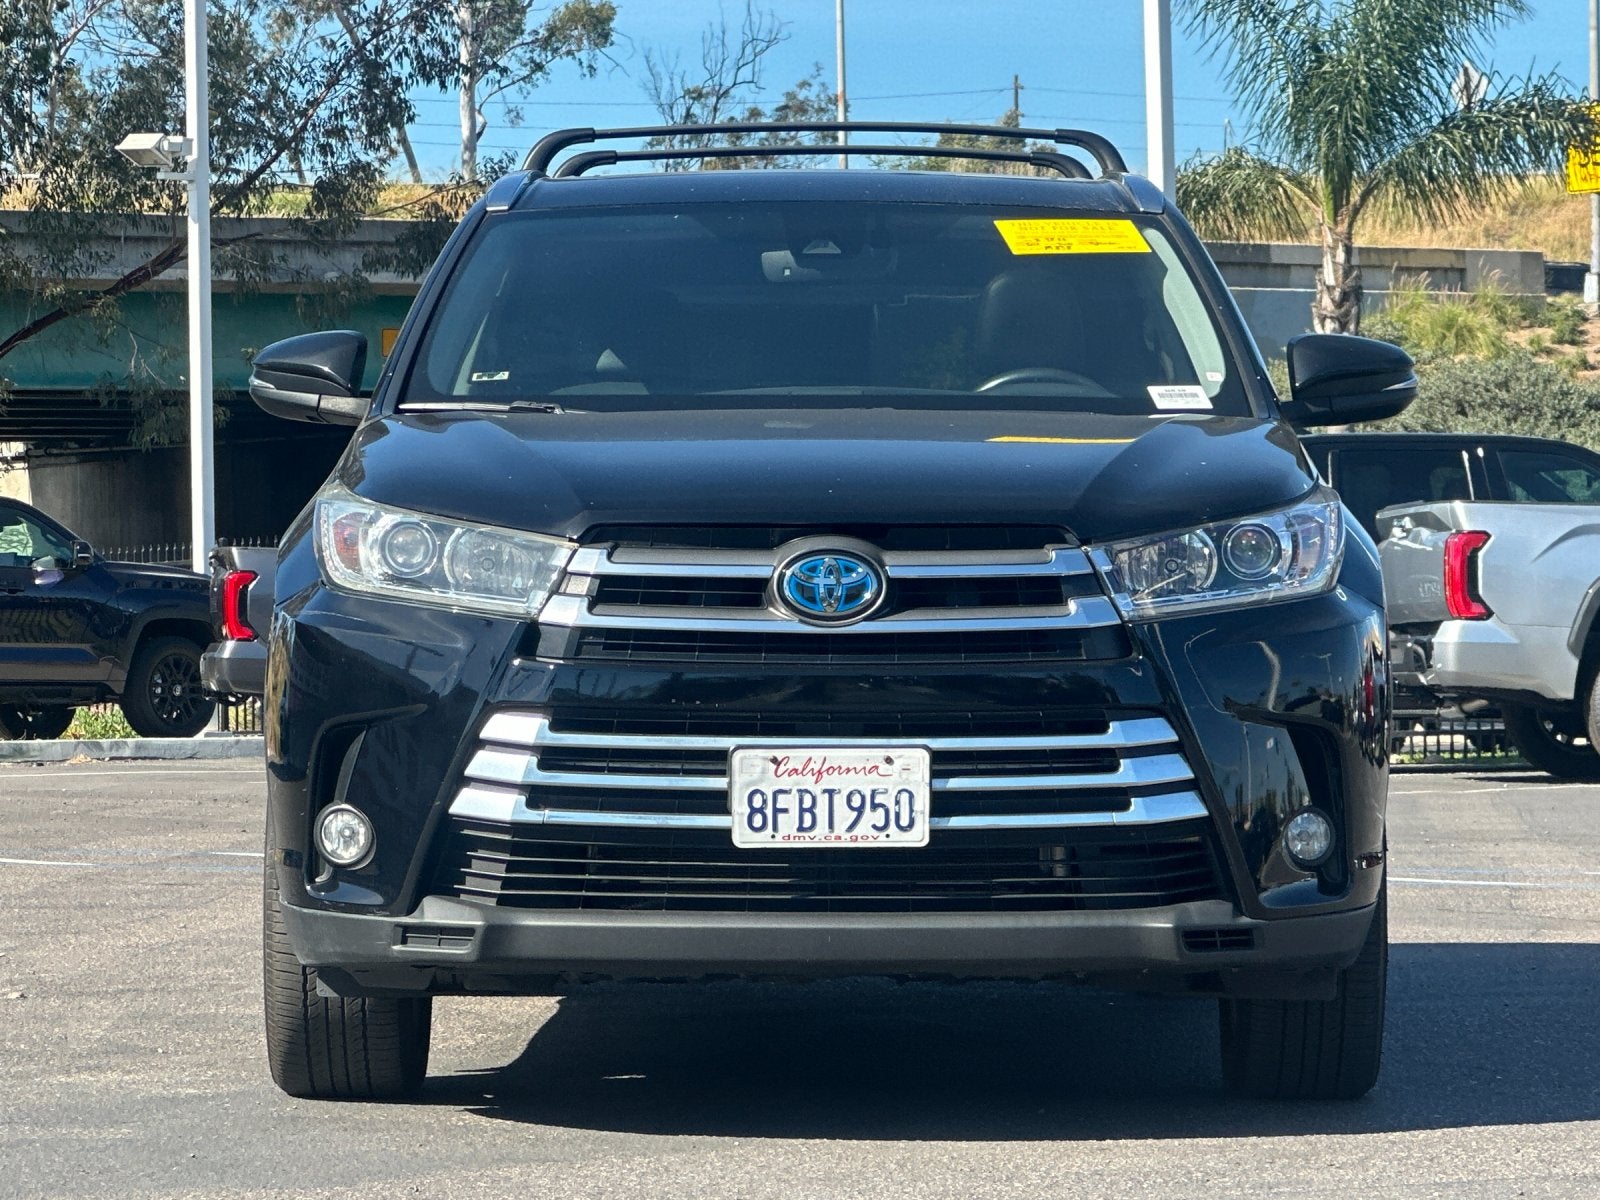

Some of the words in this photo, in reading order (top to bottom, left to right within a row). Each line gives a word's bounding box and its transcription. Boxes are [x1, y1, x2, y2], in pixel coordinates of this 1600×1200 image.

[774, 756, 893, 784] California
[747, 788, 915, 833] 8FBT950
[782, 833, 880, 842] dmv.ca.gov
